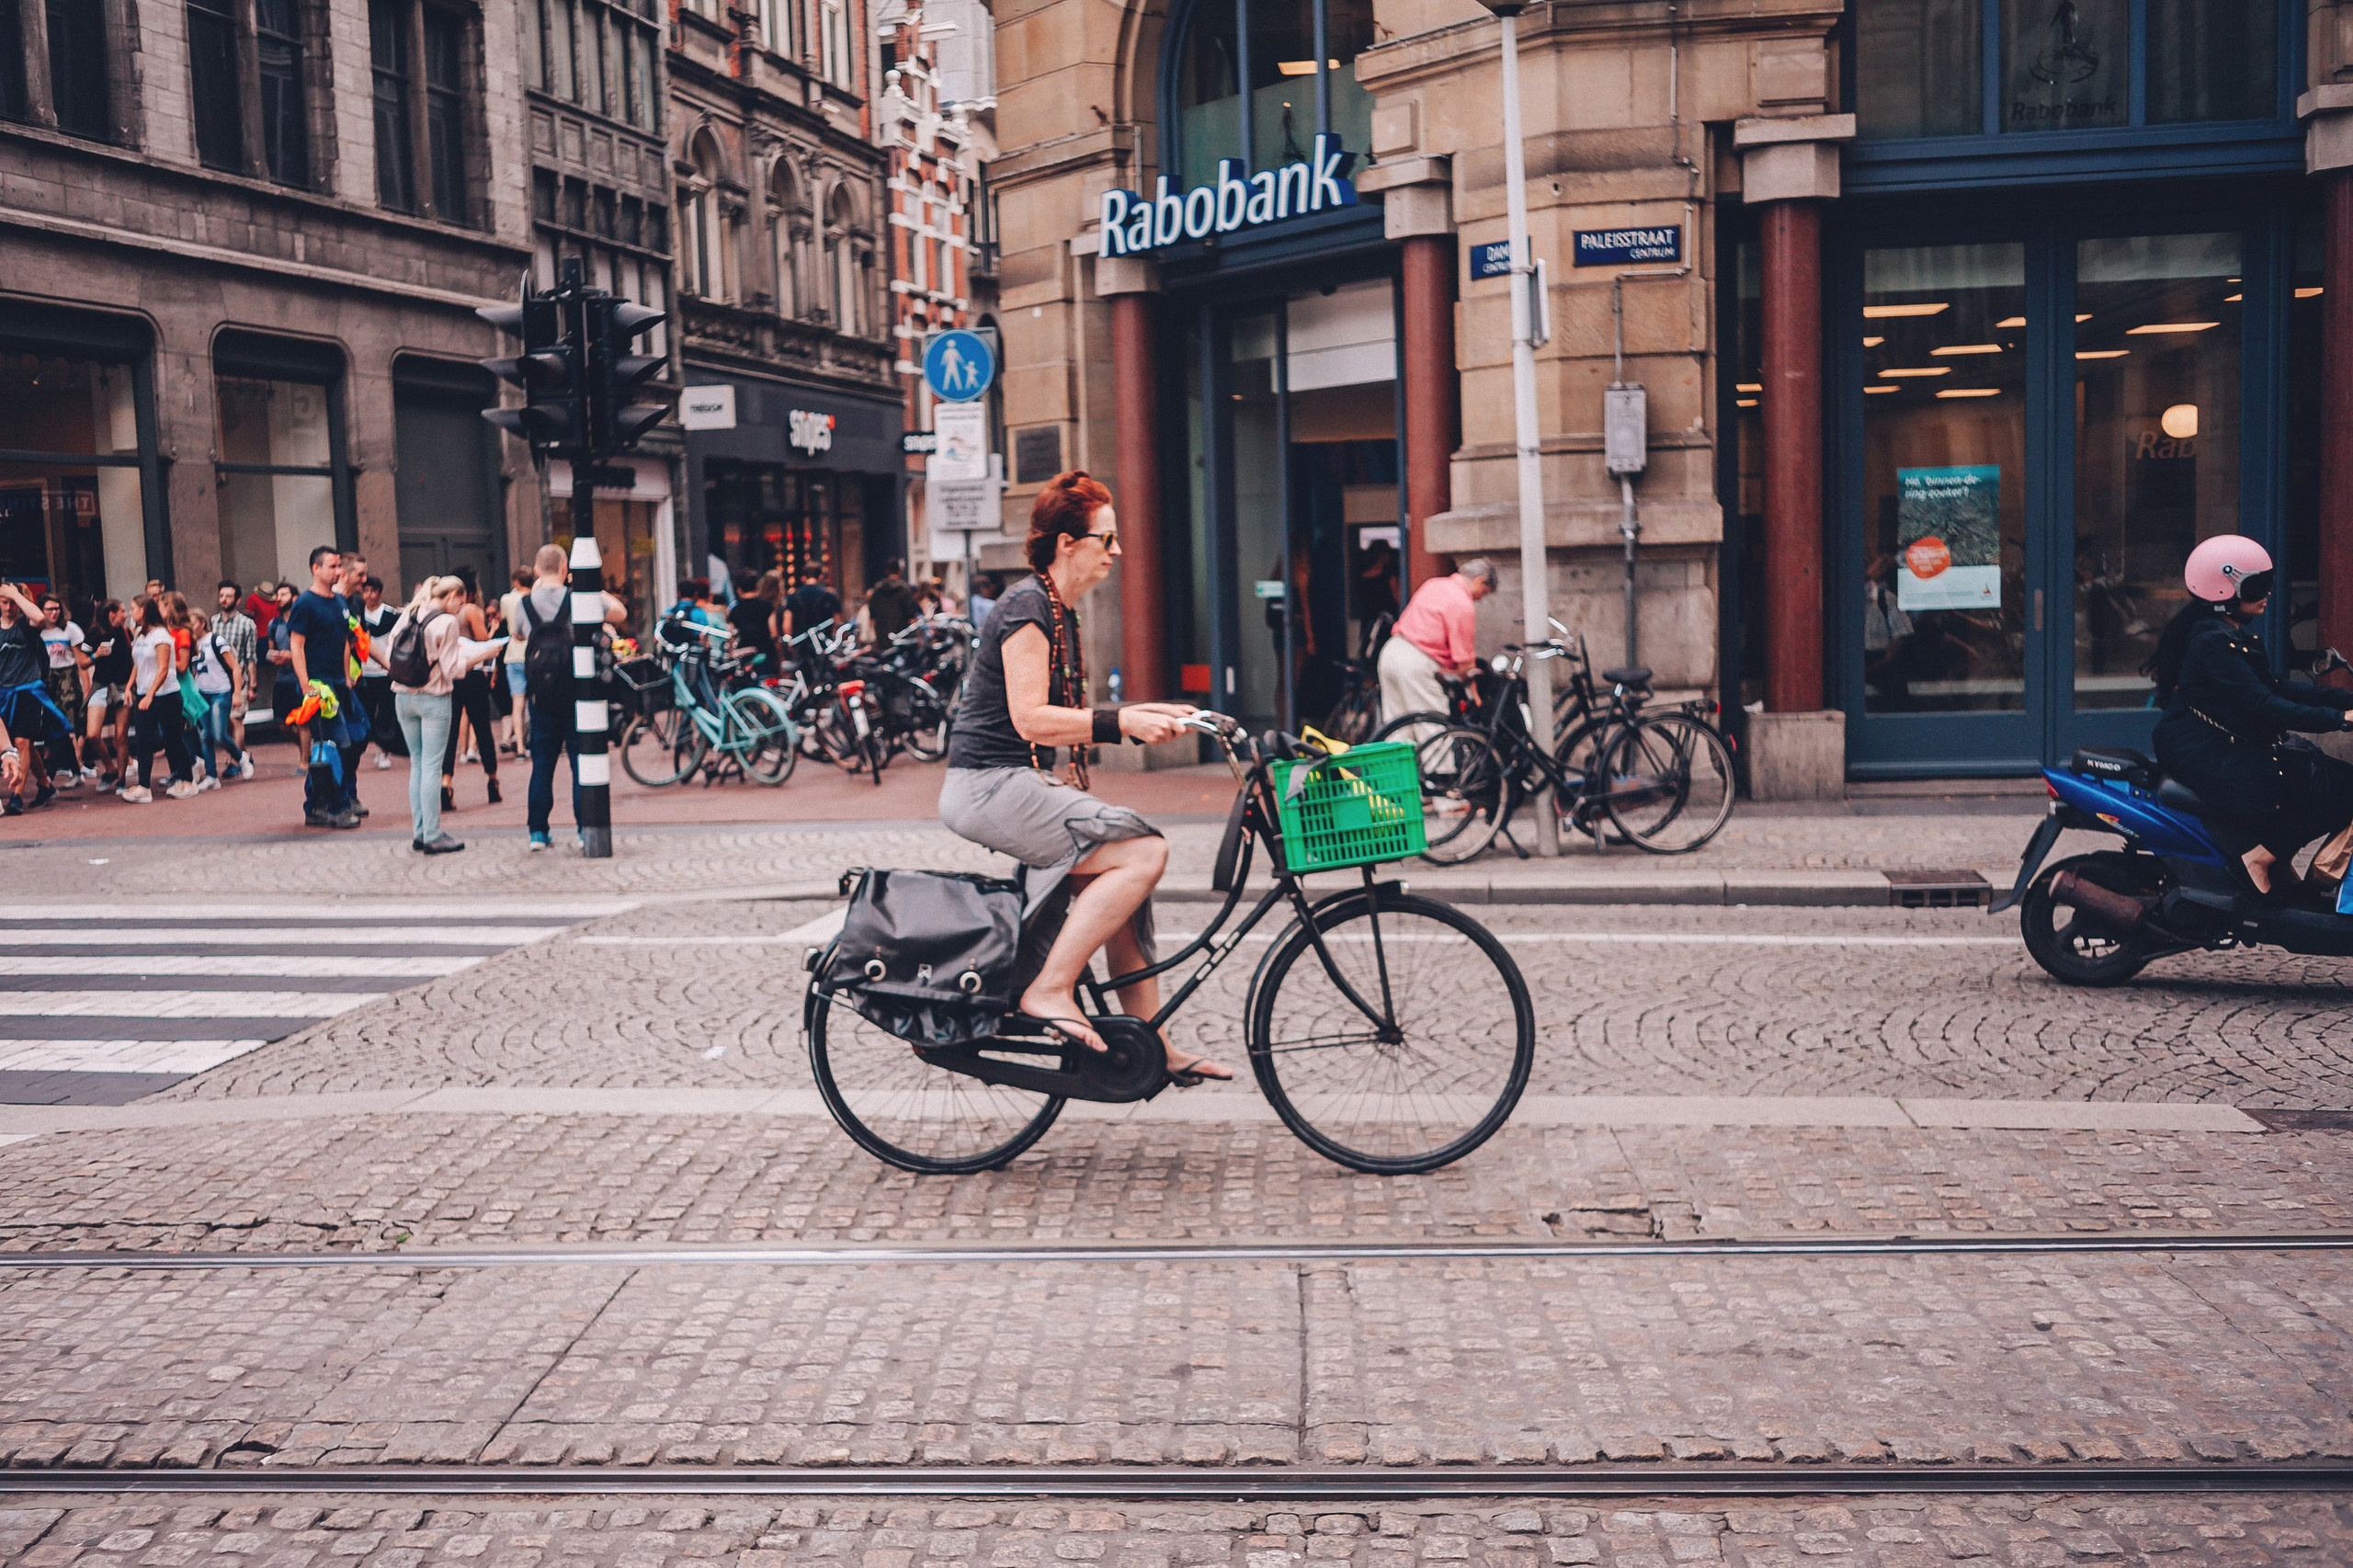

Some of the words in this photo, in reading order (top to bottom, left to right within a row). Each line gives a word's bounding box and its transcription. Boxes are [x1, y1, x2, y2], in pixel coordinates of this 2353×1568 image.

[2011, 96, 2117, 119] Rabobank
[1098, 132, 1343, 258] Rabobank
[1581, 229, 1675, 250] PALEISSTRAAT
[1630, 246, 1676, 259] CENTRUM
[2086, 758, 2121, 772] KYMCO
